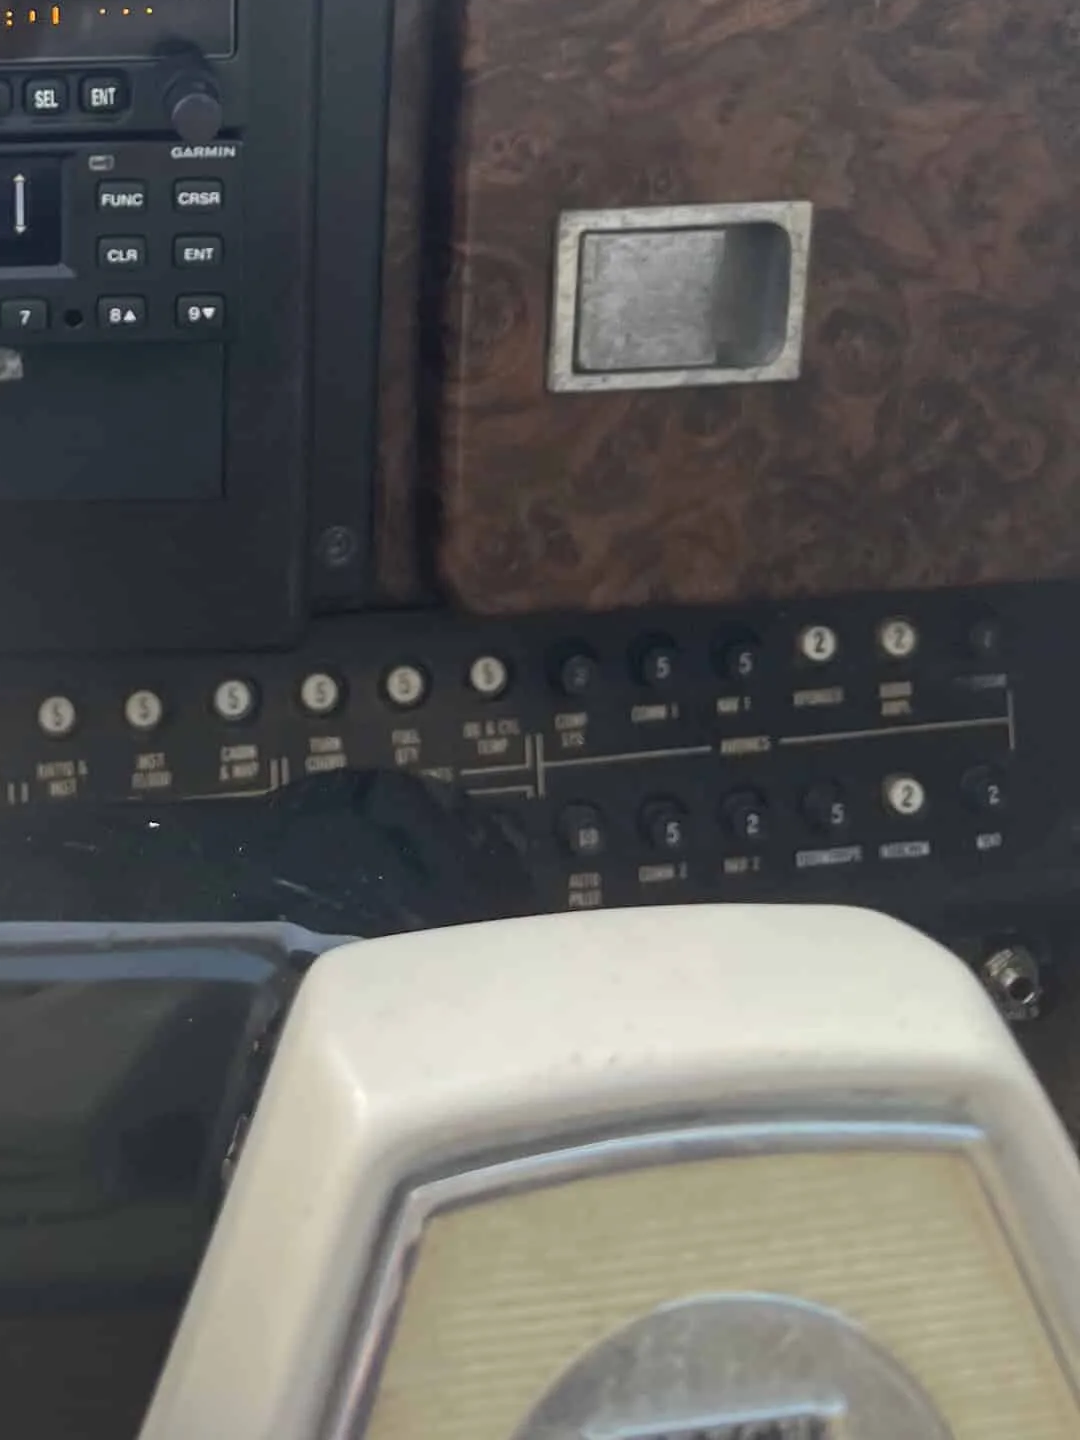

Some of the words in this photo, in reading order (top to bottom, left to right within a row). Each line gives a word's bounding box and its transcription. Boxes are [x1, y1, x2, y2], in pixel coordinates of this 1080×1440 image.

[34, 90, 59, 109] SEL
[91, 88, 117, 107] ENT
[170, 146, 237, 159] GARMIN
[100, 192, 144, 207] FUNC
[177, 191, 221, 206] CRSR
[106, 247, 138, 263] CLR
[183, 246, 214, 261] ENT
[19, 309, 32, 325] 7
[109, 307, 122, 323] 8
[187, 305, 201, 321] 9
